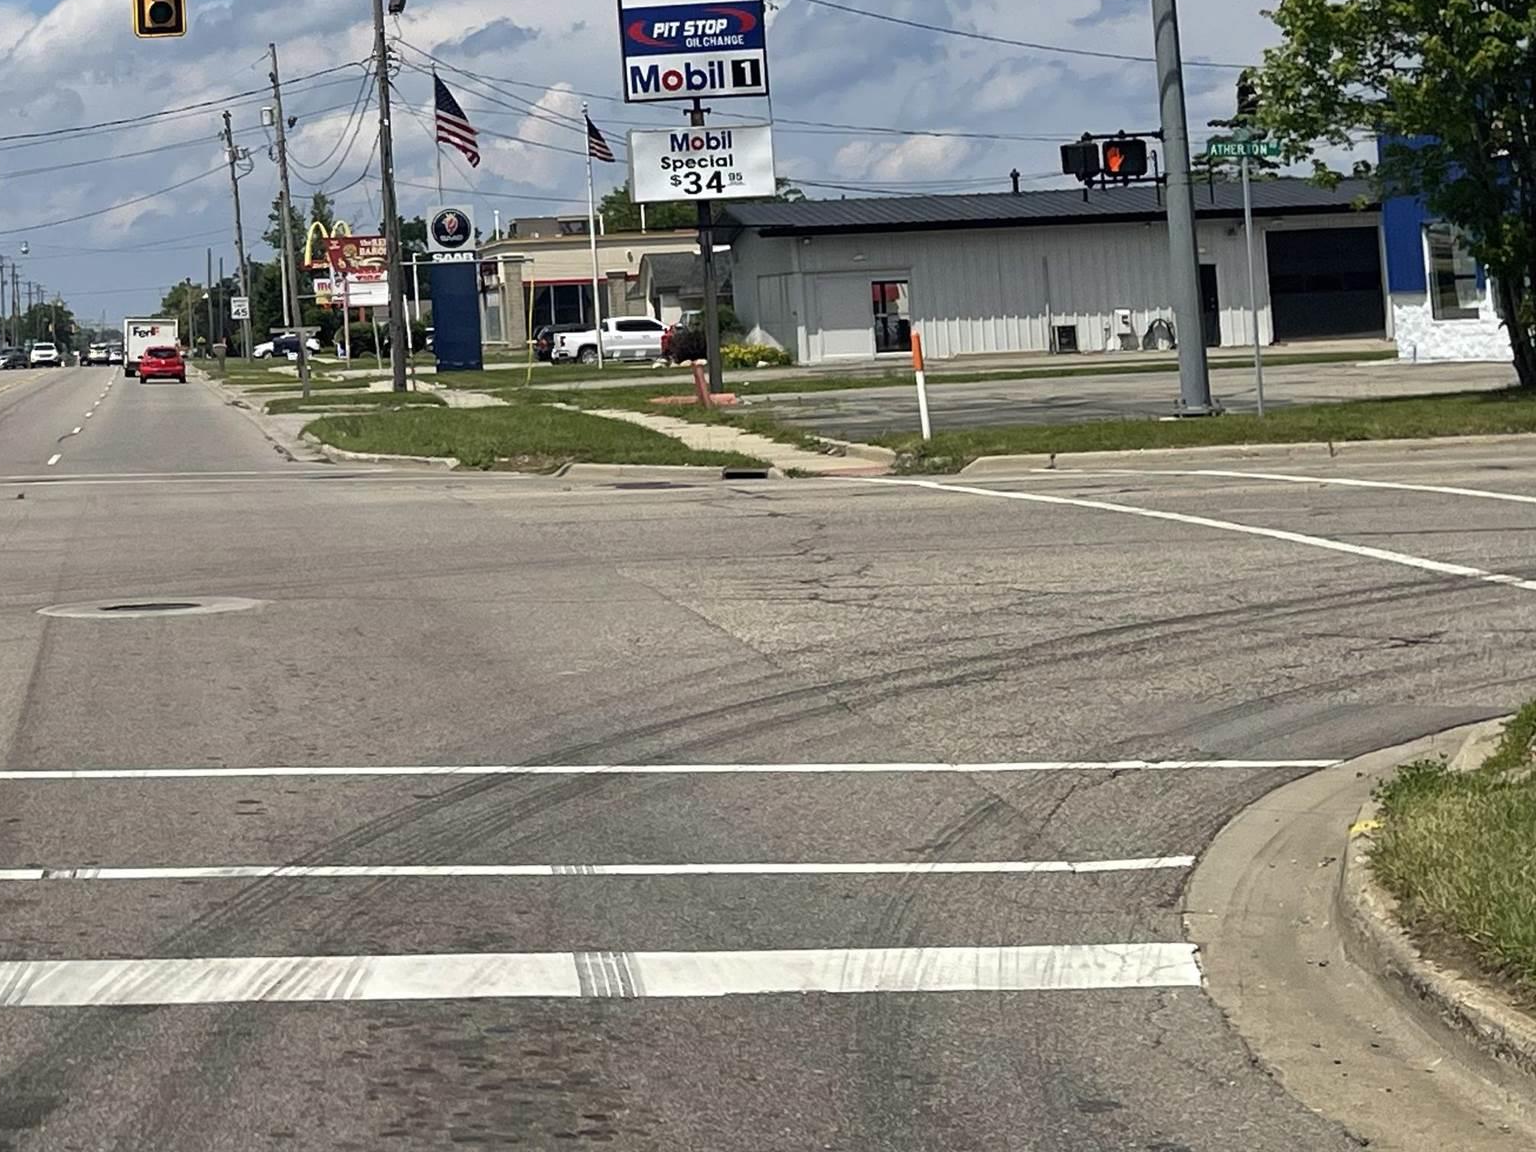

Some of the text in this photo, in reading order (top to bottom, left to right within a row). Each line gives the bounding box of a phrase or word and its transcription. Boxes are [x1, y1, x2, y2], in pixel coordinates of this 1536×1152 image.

[653, 18, 728, 38] PIT STOP
[685, 34, 744, 48] OIL CHANGE
[630, 60, 753, 94] Mobil 1
[670, 130, 732, 152] Mobil
[660, 153, 733, 172] Special
[432, 251, 474, 263] SAAB
[233, 307, 248, 317] 45
